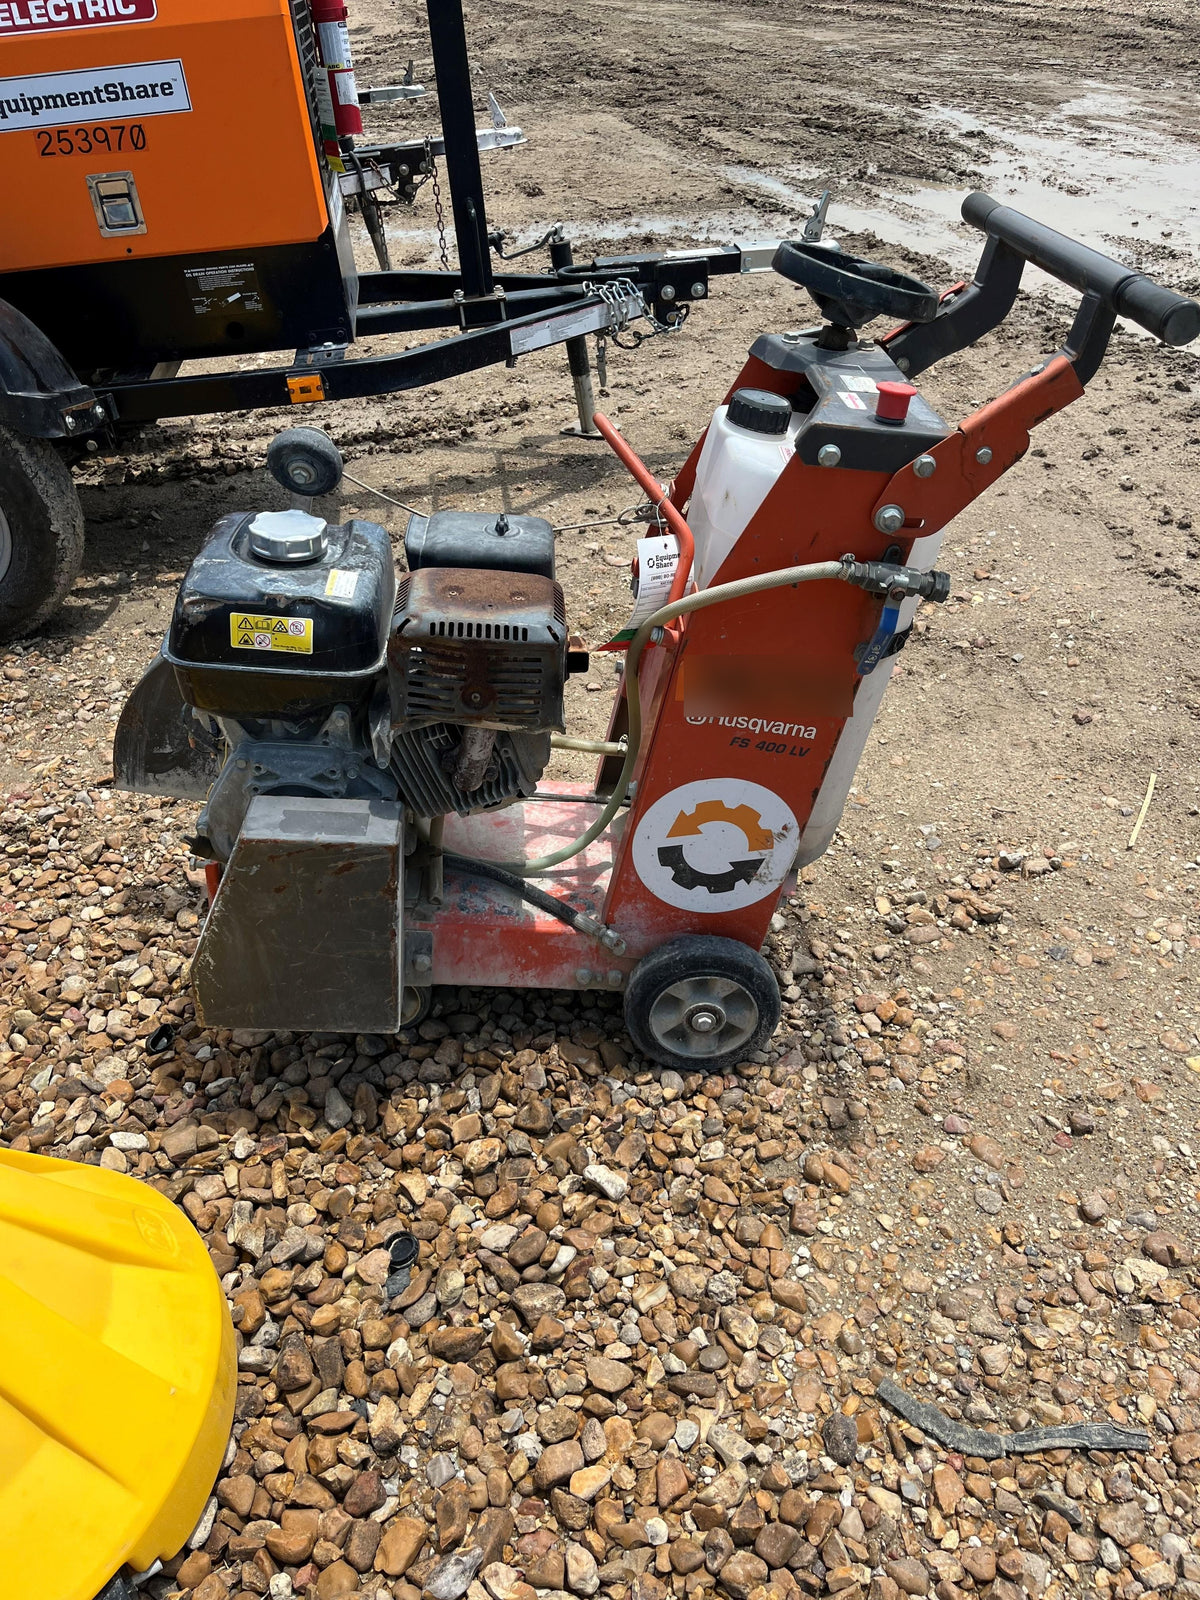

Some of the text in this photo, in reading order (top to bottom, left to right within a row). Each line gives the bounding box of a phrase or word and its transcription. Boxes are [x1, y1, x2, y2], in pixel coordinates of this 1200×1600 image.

[0, 0, 137, 27] ELECTRIC
[36, 124, 147, 157] 253970
[729, 736, 810, 757] FS 400 LV
